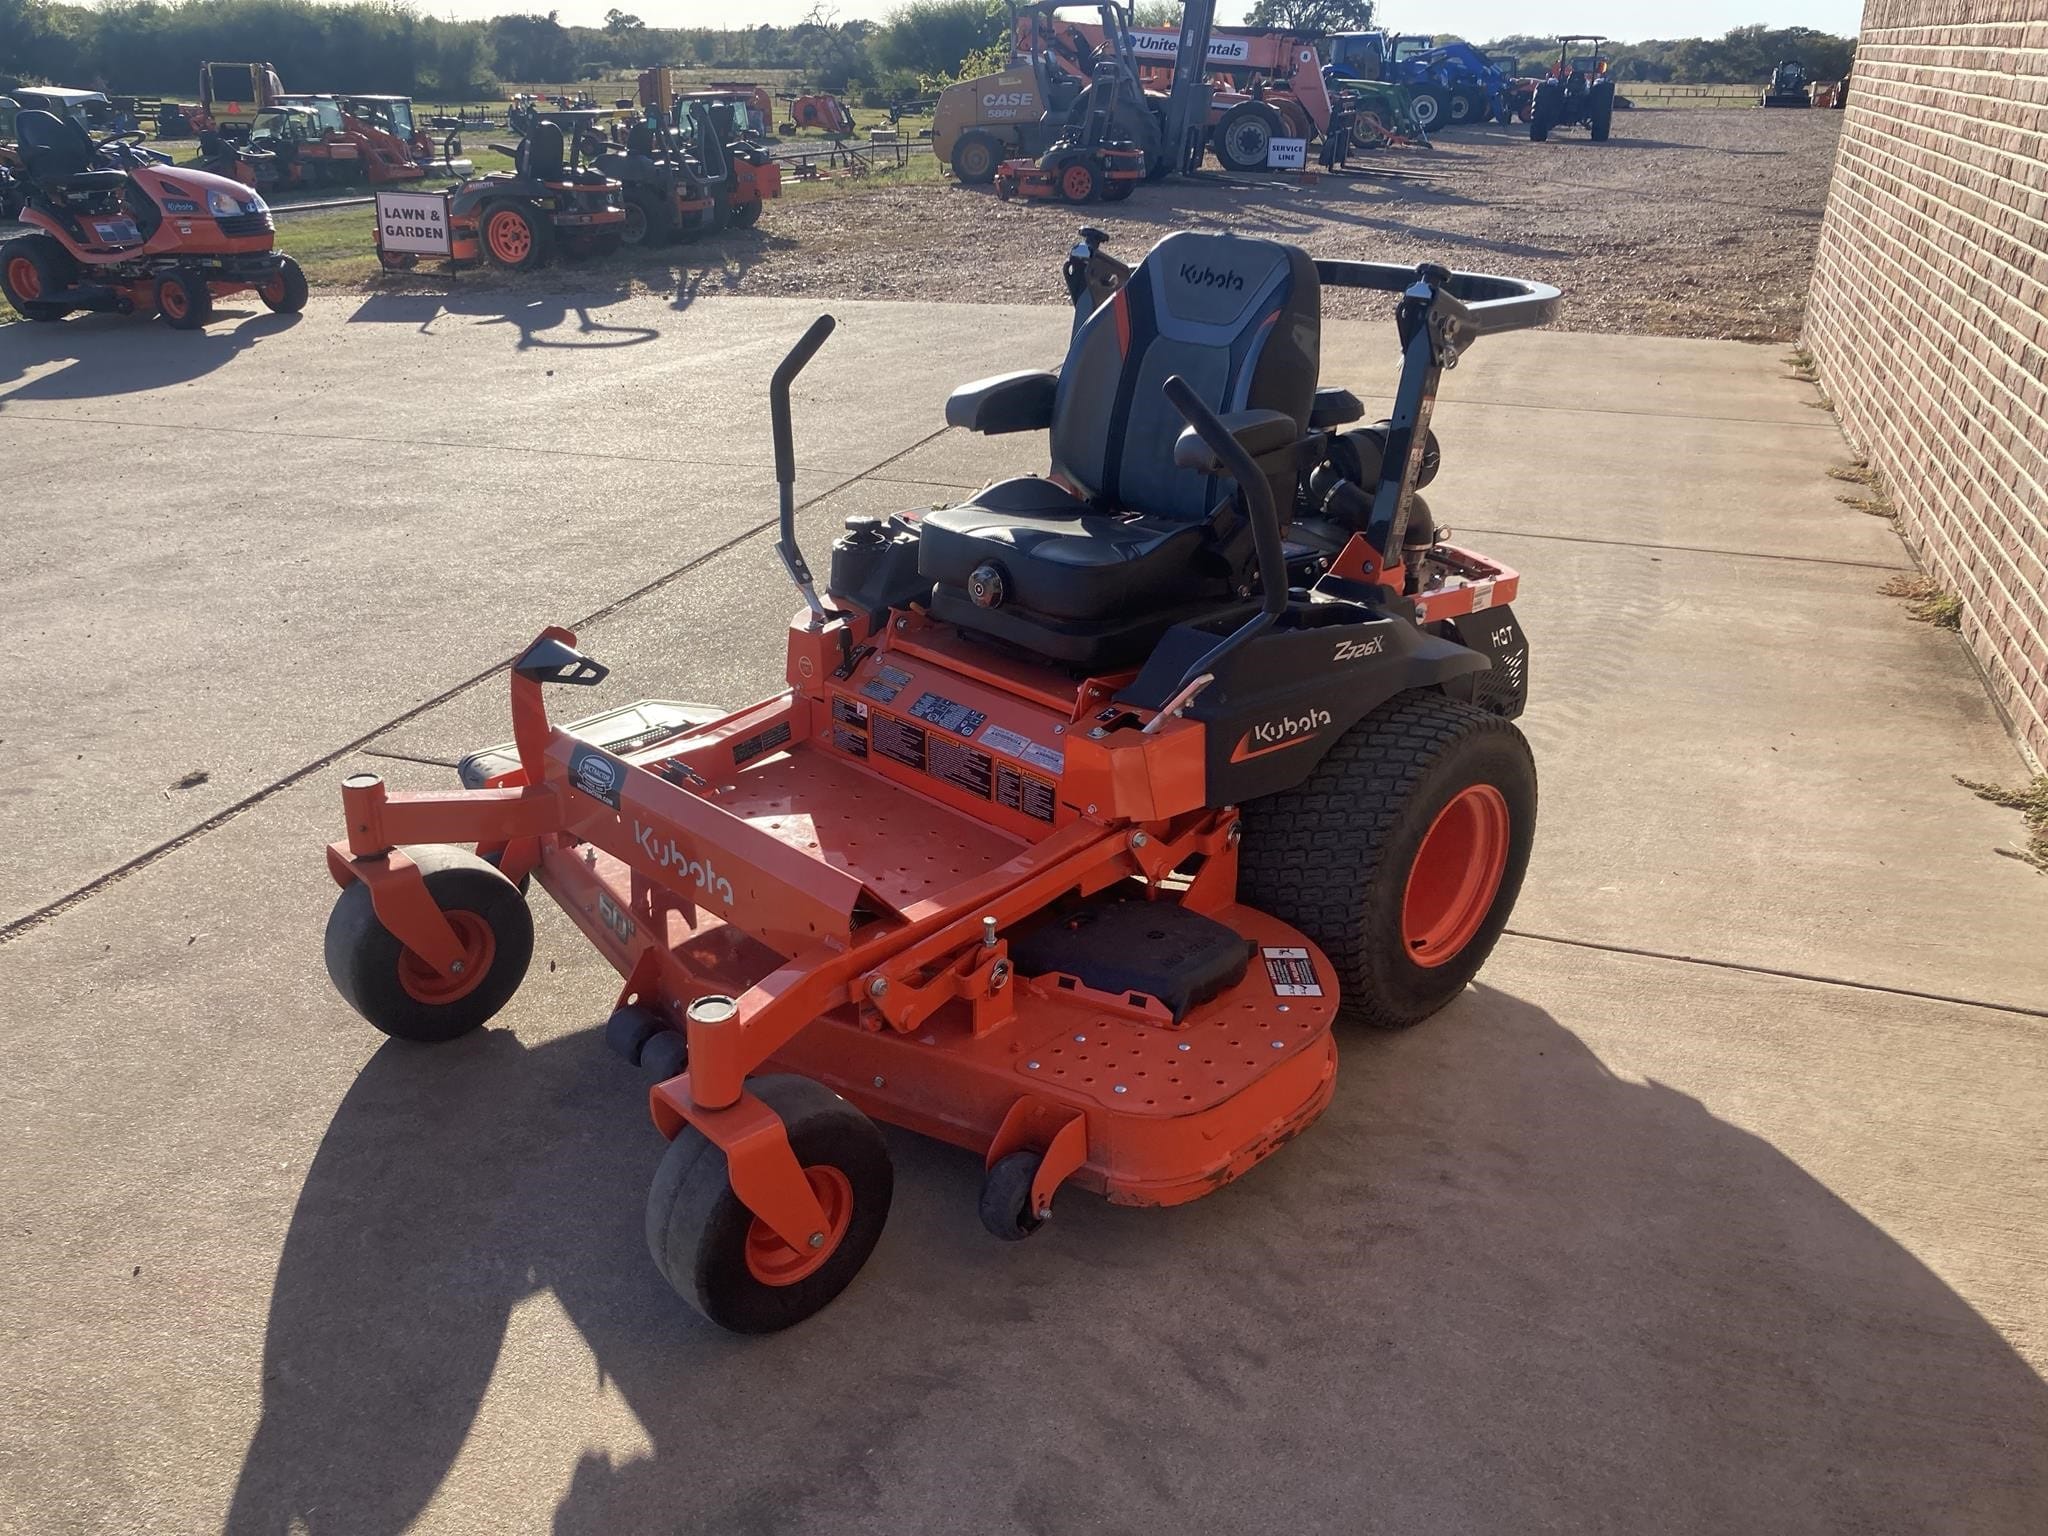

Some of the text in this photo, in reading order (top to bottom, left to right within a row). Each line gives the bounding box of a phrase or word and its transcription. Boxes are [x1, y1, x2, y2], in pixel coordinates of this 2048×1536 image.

[1140, 36, 1242, 57] Unite ntals
[983, 92, 1034, 107] CASE
[1272, 144, 1303, 153] SERVICE
[384, 207, 441, 222] LAWN &
[385, 225, 444, 239] GARDEN
[1180, 263, 1244, 291] Kubota
[1333, 634, 1384, 662] Z726X
[1491, 625, 1513, 649] HOT
[1254, 708, 1332, 742] Kubota
[633, 820, 735, 906] Kubota
